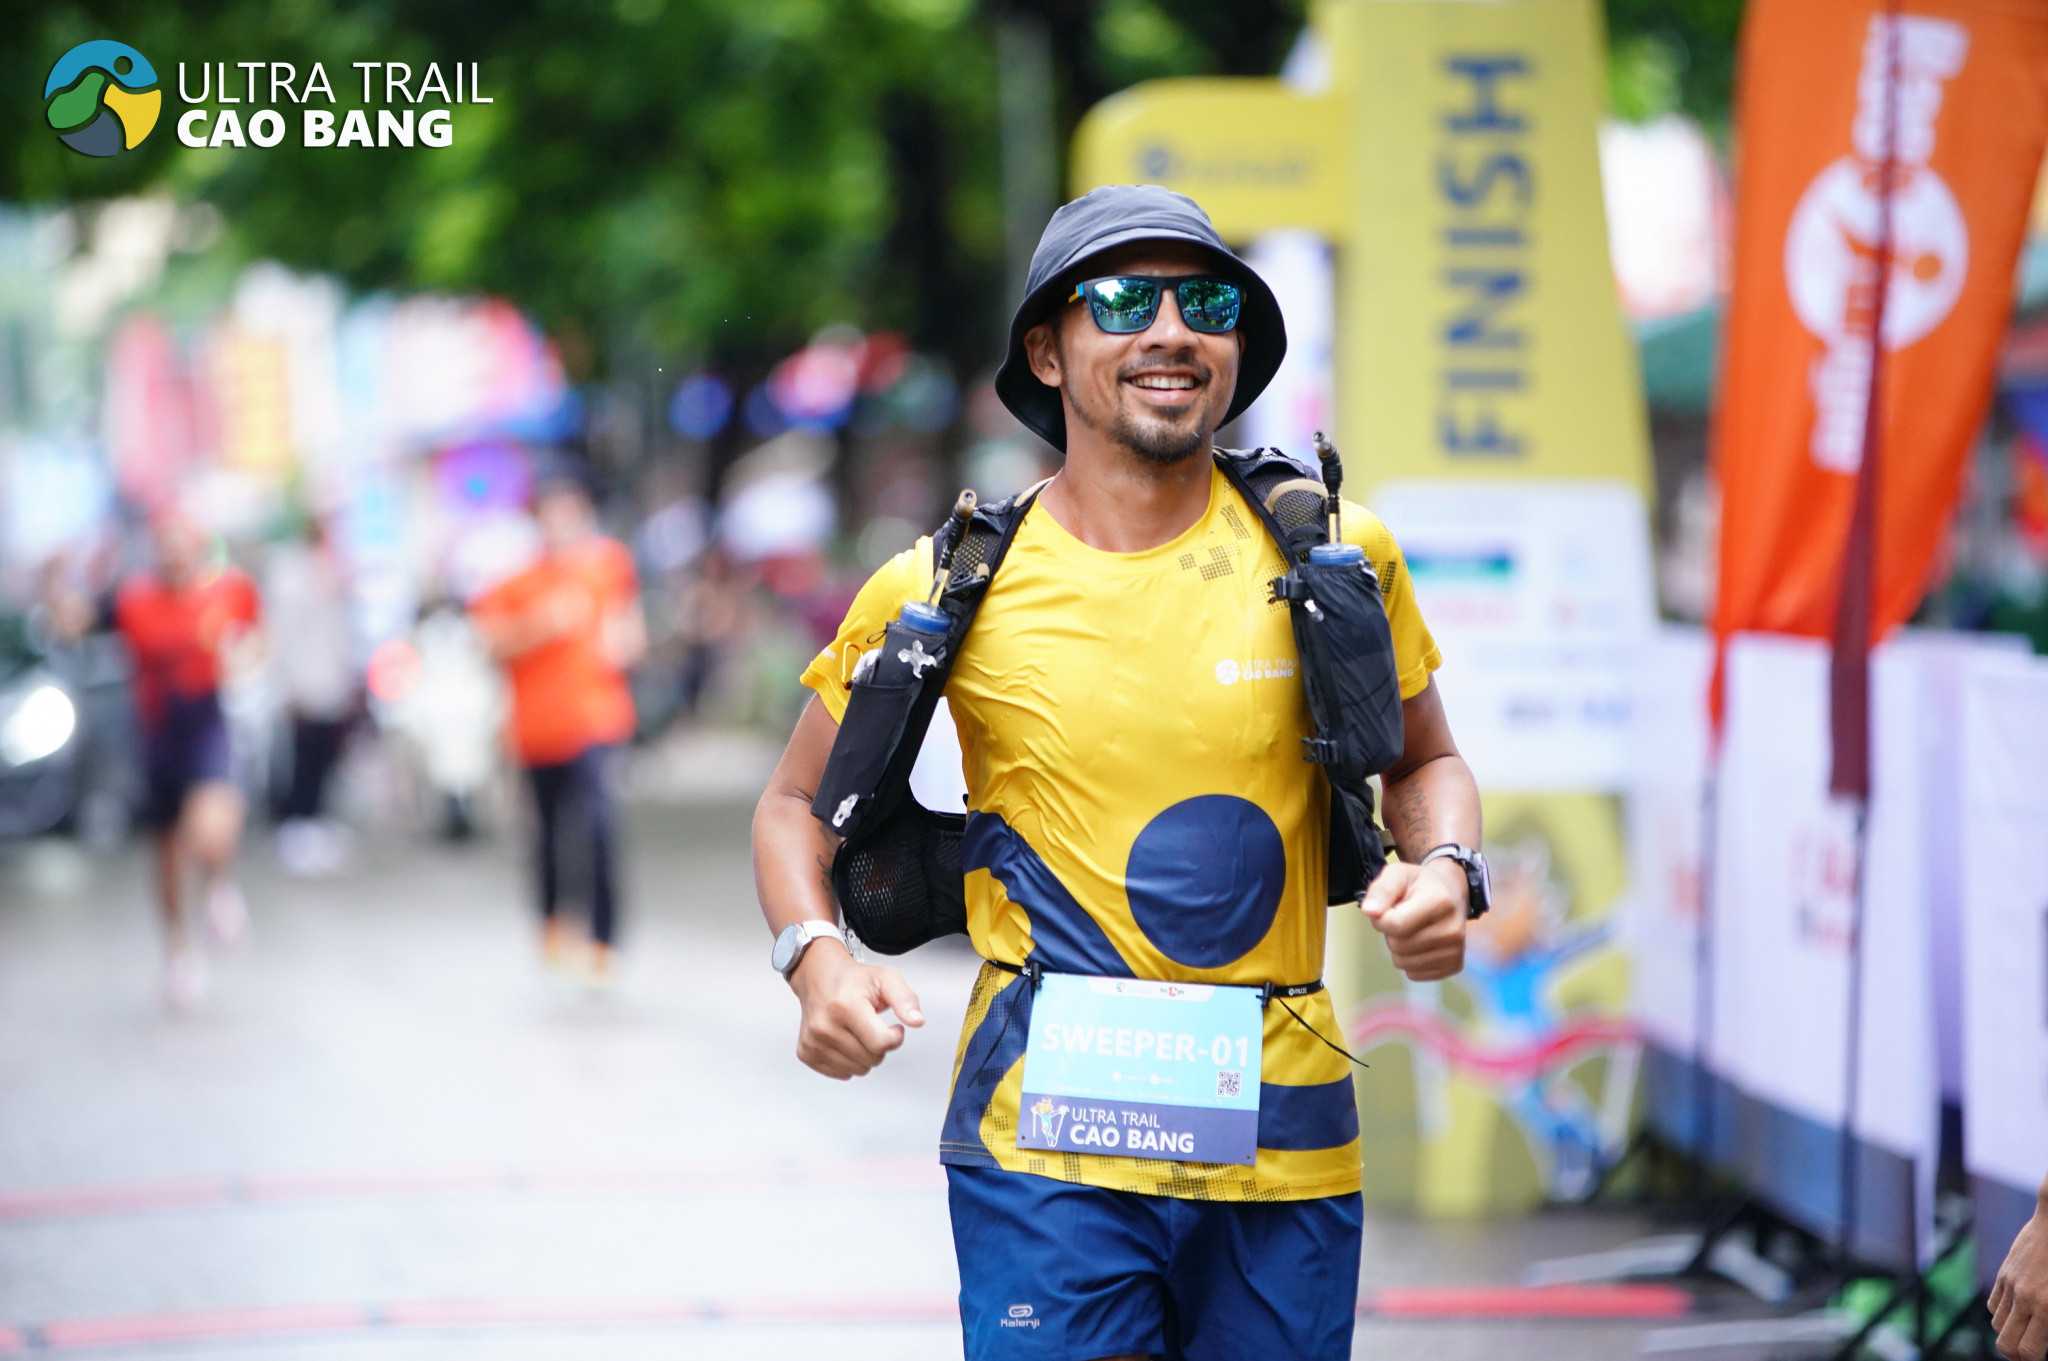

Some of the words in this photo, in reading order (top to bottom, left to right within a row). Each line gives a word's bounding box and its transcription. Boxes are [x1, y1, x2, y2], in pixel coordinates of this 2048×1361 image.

[1437, 50, 1533, 461] FINISH
[1241, 659, 1272, 671] ULTRA
[1264, 668, 1295, 679] BANG
[1042, 1022, 1249, 1068] SWEEPER-01
[1072, 1107, 1117, 1125] ULTRA
[1121, 1111, 1161, 1129] TRAIL
[1070, 1124, 1120, 1147] CAO
[1127, 1128, 1194, 1154] BANG
[1000, 1318, 1040, 1330] Kalenji
